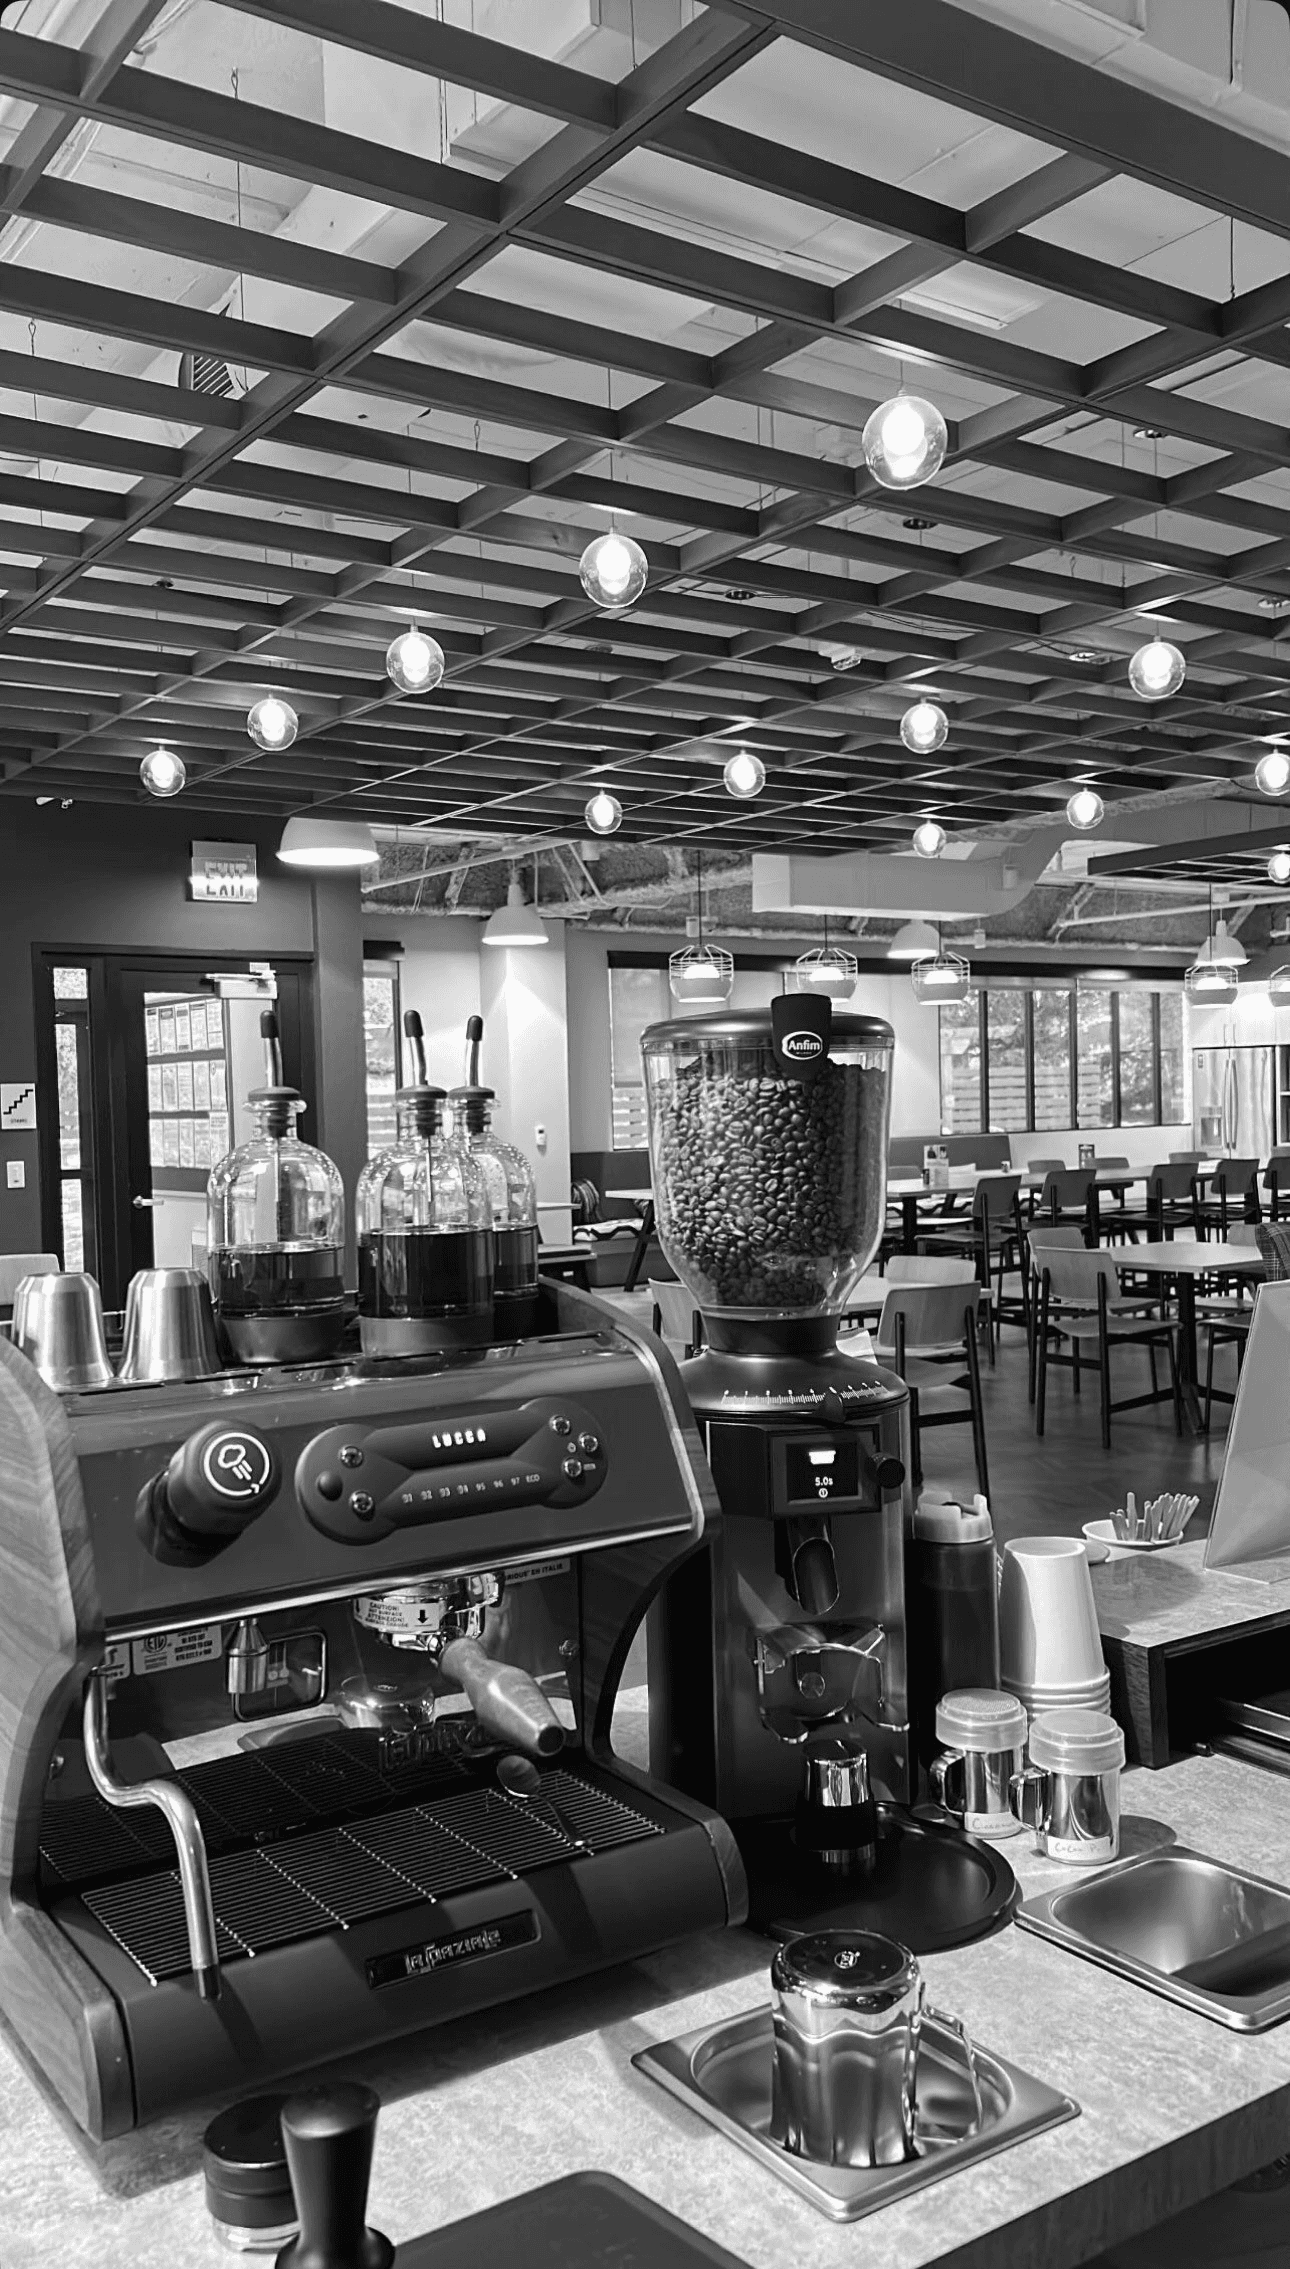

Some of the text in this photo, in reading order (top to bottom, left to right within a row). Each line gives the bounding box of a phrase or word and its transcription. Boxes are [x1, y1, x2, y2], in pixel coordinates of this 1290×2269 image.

[205, 862, 247, 896] EXIT
[789, 1039, 820, 1050] Anfim
[511, 1476, 520, 1486] 97
[815, 1476, 834, 1487] 5.0s
